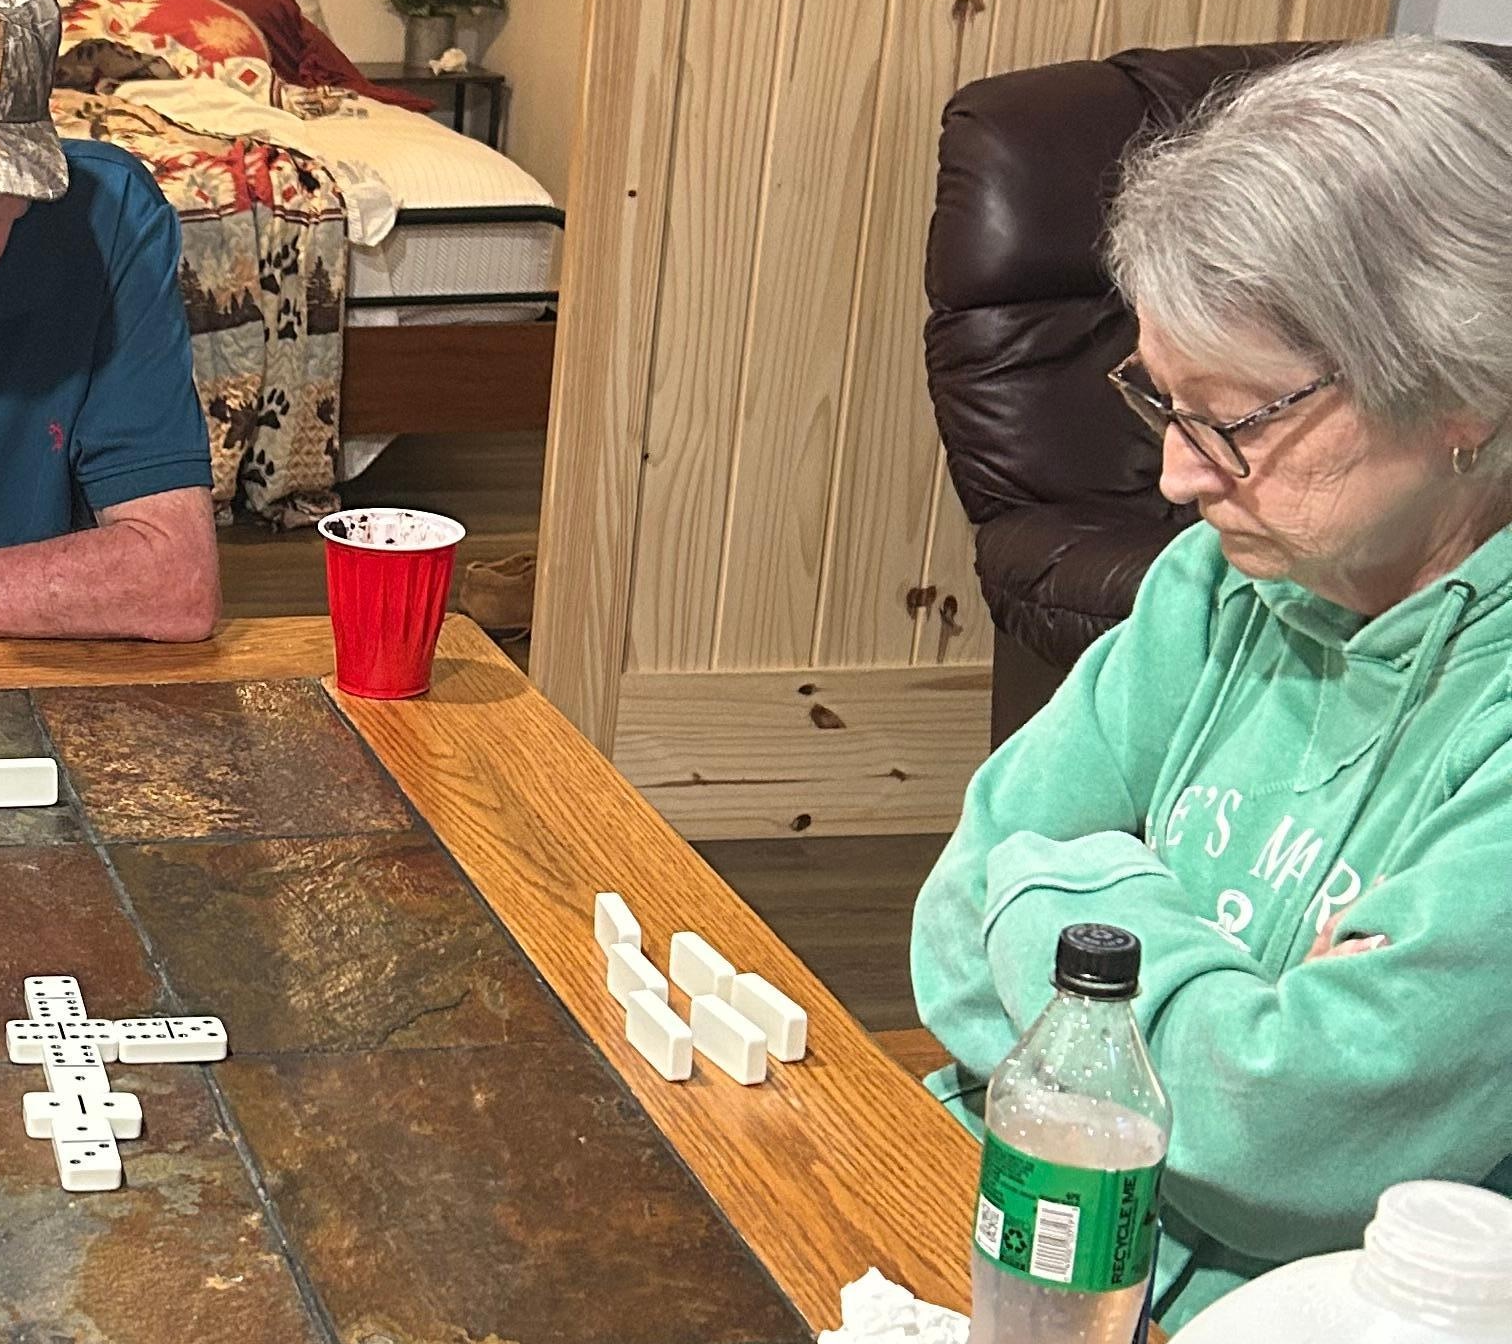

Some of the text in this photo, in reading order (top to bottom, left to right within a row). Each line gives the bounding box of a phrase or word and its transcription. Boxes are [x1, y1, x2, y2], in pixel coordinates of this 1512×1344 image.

[1249, 814, 1361, 935] MAR
[1111, 1207, 1133, 1284] RECYCLE
[1122, 1175, 1137, 1205] ME
